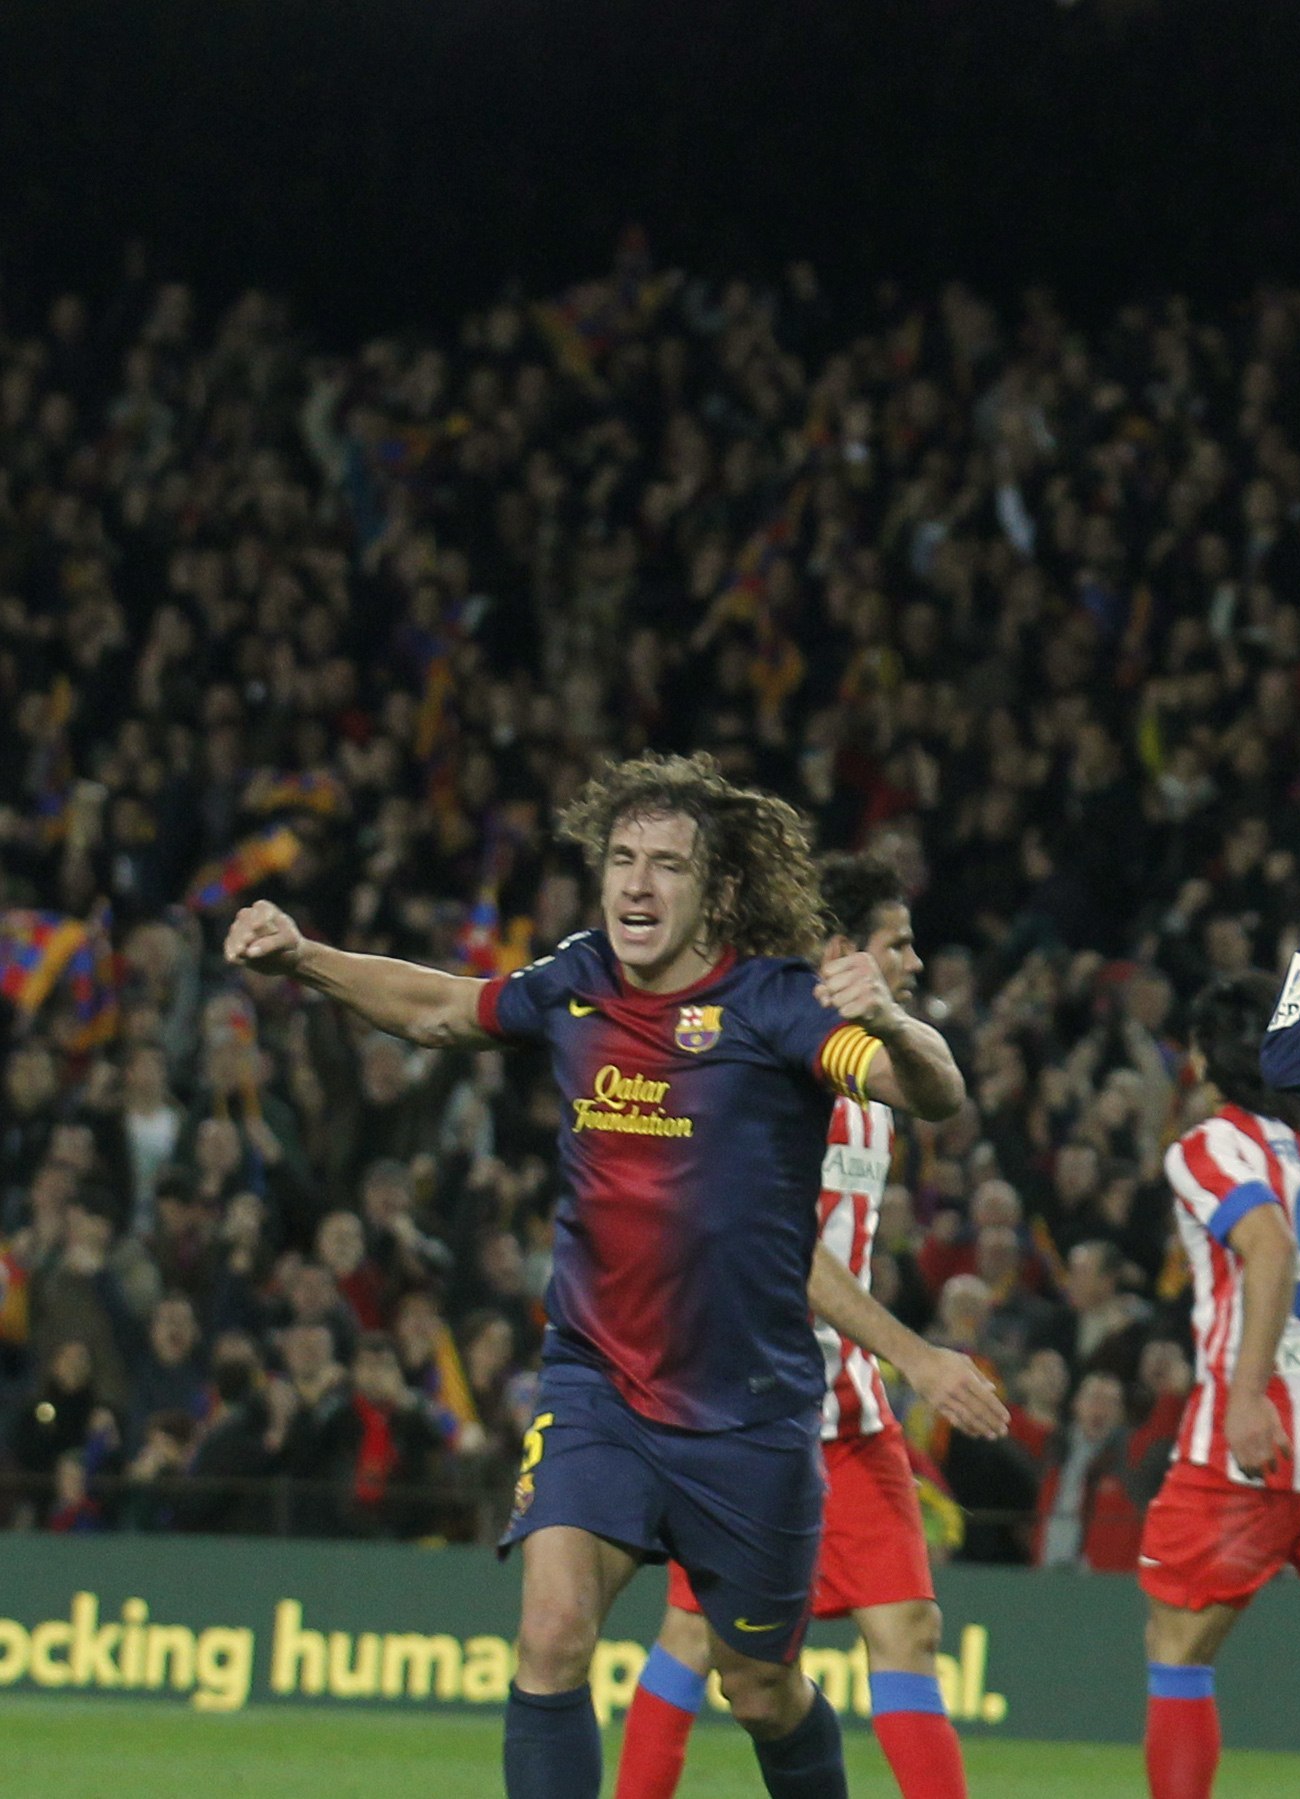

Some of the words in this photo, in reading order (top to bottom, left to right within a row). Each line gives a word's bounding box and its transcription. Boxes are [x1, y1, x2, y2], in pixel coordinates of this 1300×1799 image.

[594, 1064, 671, 1110] Qatar
[572, 1098, 693, 1138] Foundation
[520, 1411, 554, 1473] 5
[0, 1591, 254, 1712] ocking
[270, 1599, 516, 1703] huma
